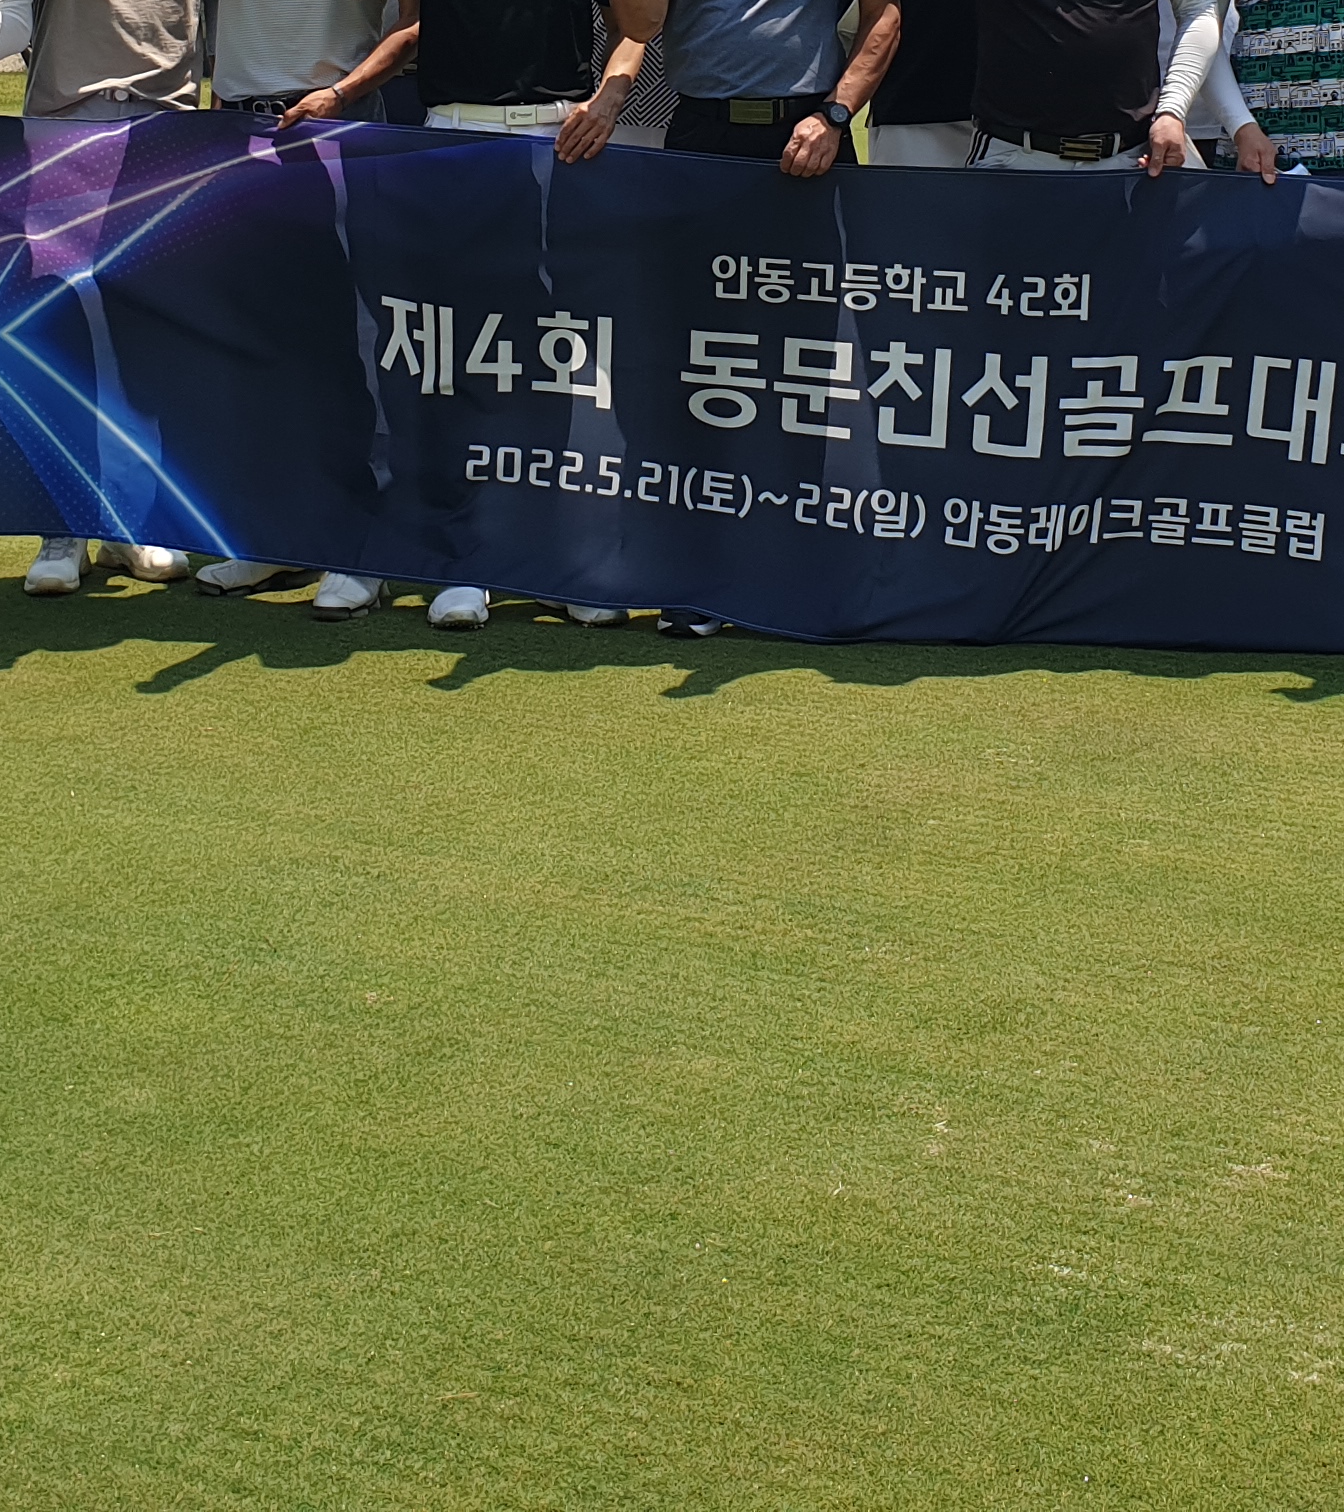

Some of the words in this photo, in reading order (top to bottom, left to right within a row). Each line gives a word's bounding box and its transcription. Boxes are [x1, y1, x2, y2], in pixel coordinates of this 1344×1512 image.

[711, 254, 969, 313] 안동고등학교
[986, 273, 1091, 321] 42회
[380, 295, 613, 410] 제4회
[465, 444, 926, 539] 2022.5.21(토)~22(일)
[943, 497, 1325, 562] 안동레이크골프클럽
